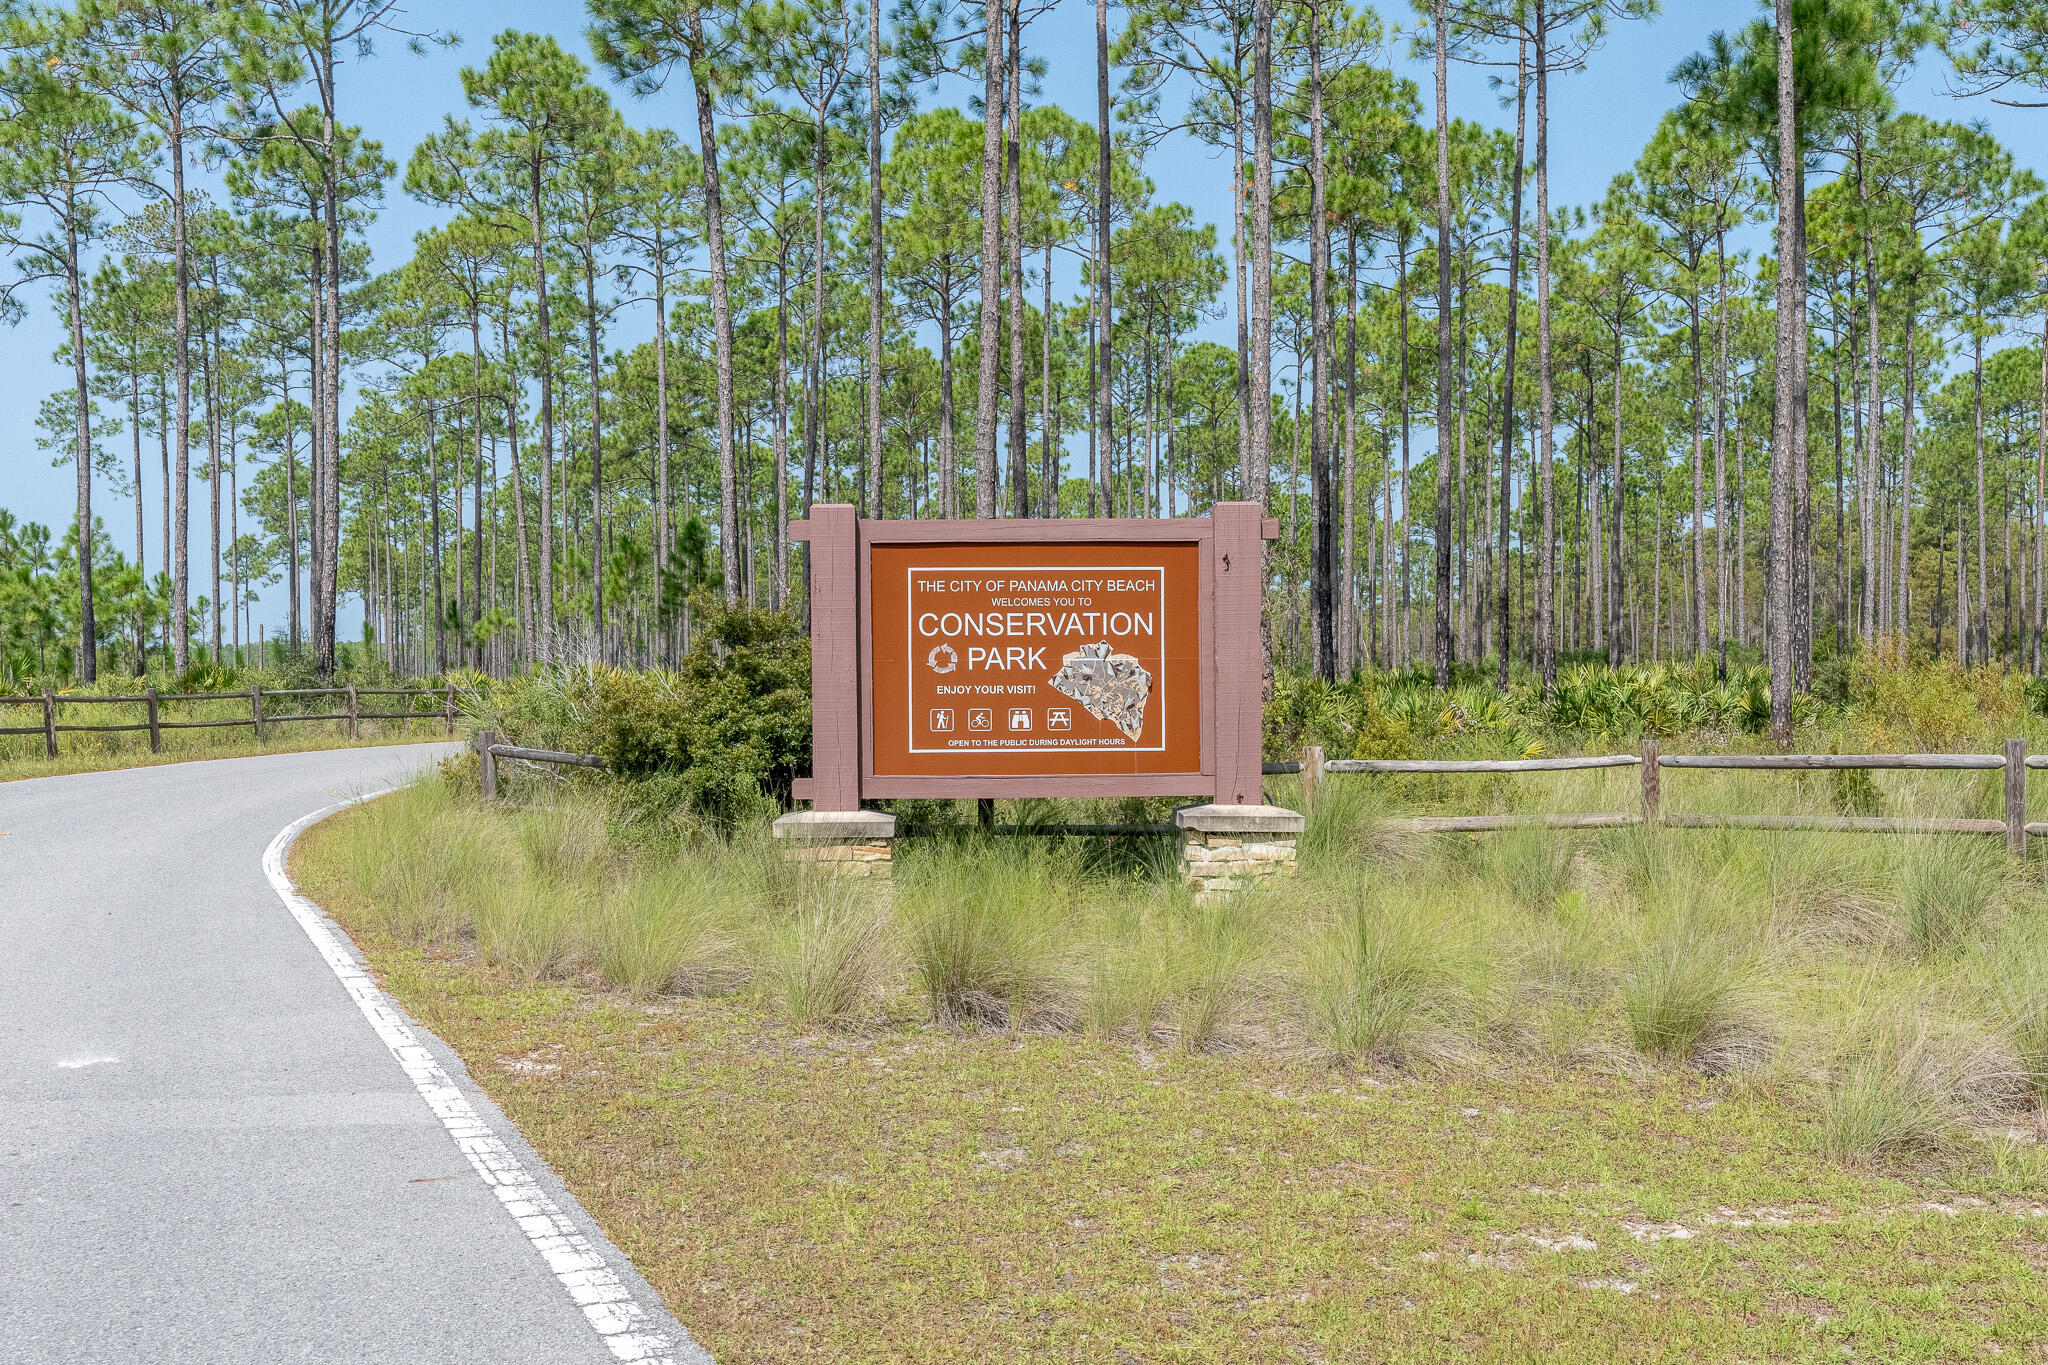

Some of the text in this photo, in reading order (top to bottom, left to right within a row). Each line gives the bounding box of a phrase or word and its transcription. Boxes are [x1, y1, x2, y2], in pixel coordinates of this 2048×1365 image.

[918, 580, 1155, 592] THE CITY OF PANAMA CITY BEACH
[992, 598, 1091, 606] WELCOMES YOU TO
[918, 612, 1153, 636] CONSERVATION
[968, 647, 1047, 670] PARK
[937, 685, 1036, 694] ENJOY YOUR VISIT!
